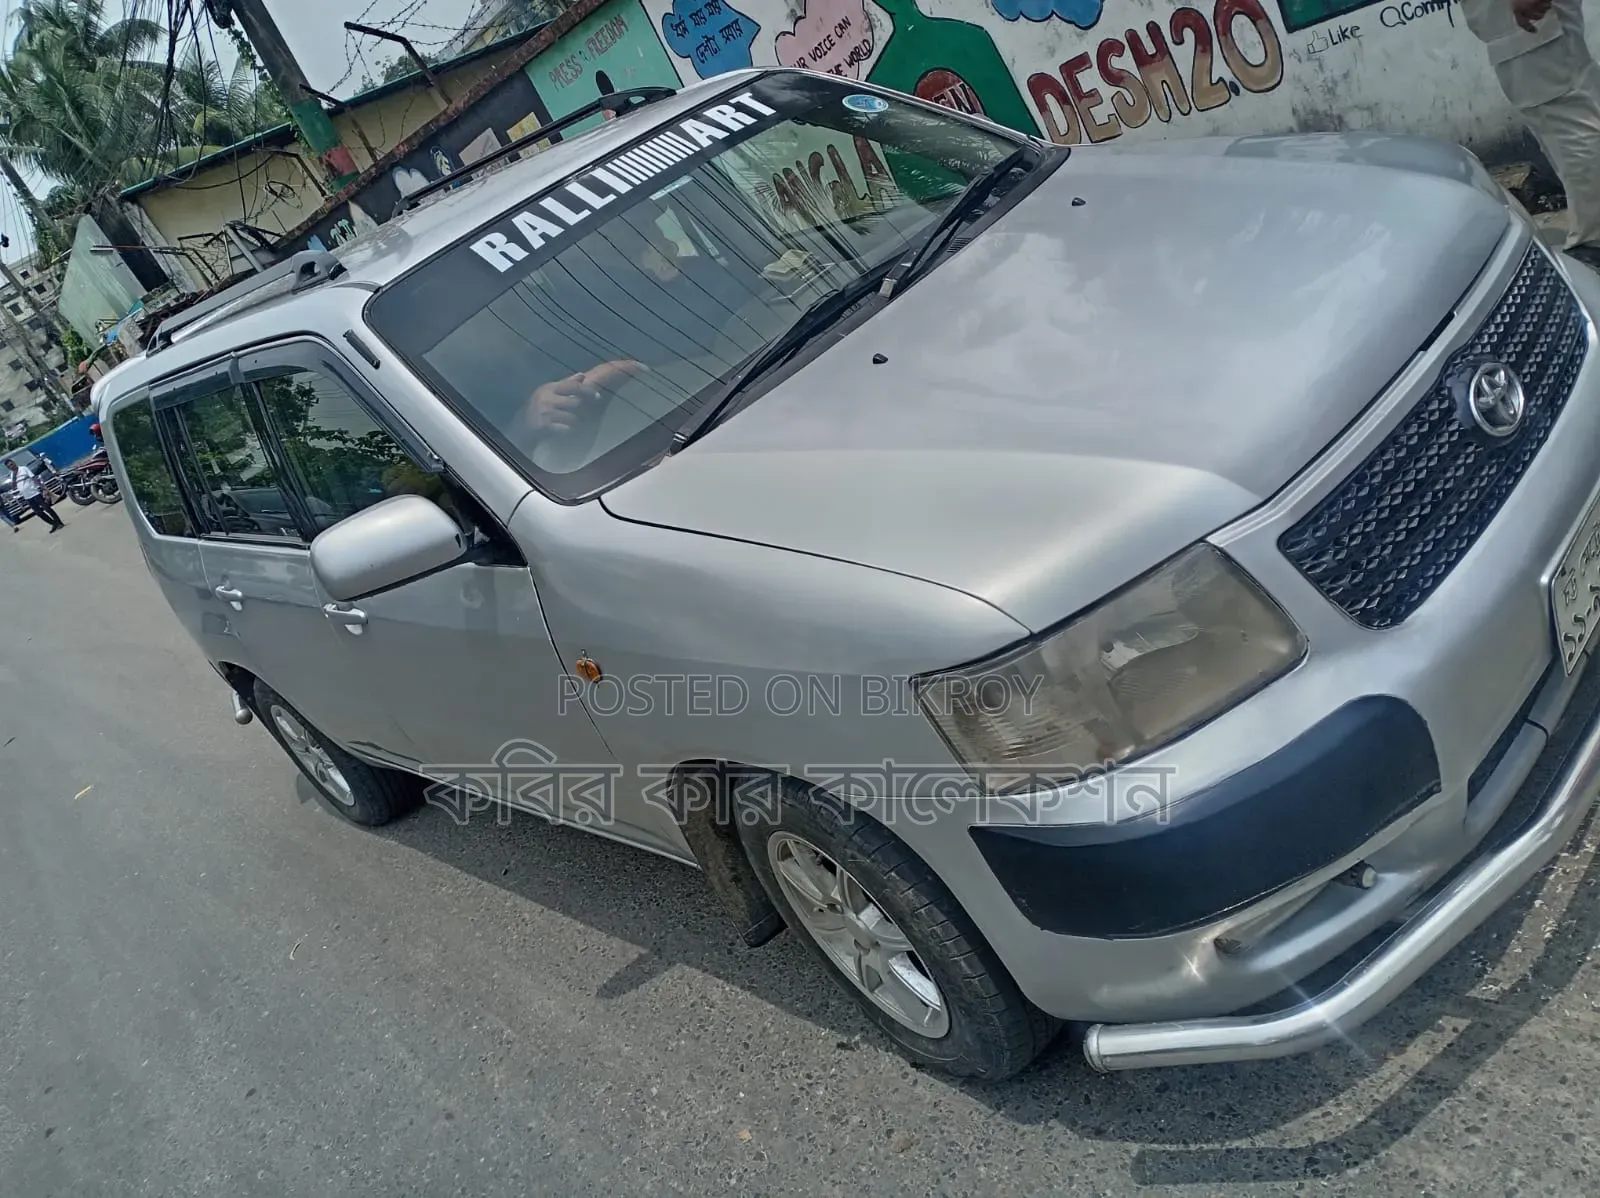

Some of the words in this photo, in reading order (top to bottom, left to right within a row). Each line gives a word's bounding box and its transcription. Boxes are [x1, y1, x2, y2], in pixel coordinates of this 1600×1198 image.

[808, 34, 836, 62] VOICE
[834, 15, 852, 39] CAN
[1328, 24, 1361, 46] Like
[843, 38, 872, 68] WORLD
[549, 52, 584, 90] PRESS
